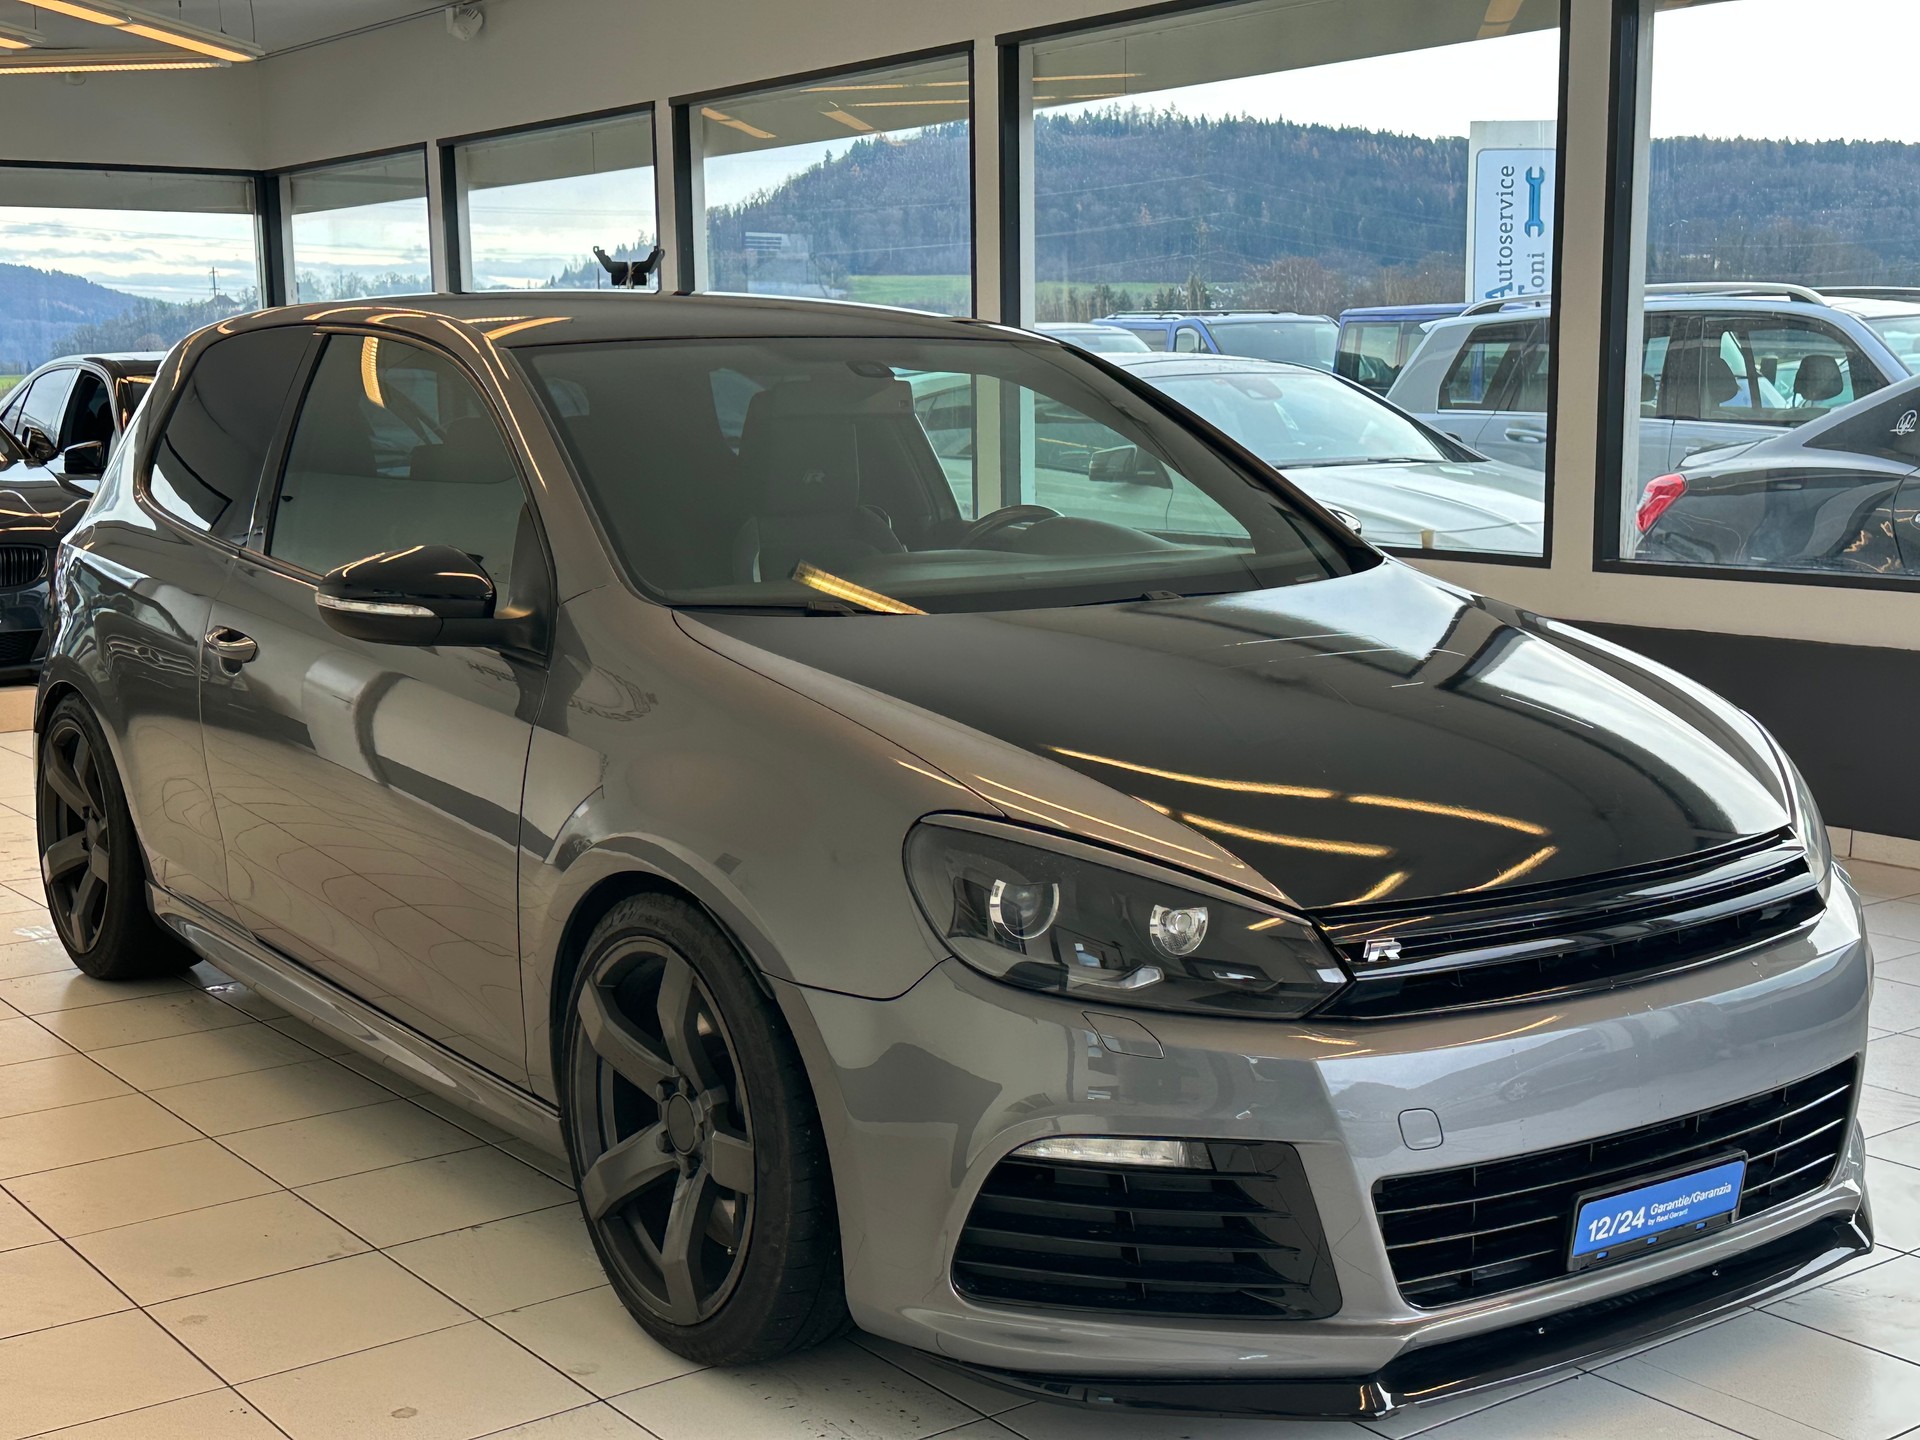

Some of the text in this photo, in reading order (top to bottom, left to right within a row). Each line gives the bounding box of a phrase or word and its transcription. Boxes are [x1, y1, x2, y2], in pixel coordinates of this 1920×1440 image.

[1485, 165, 1515, 299] Autoservice
[1363, 937, 1402, 962] R
[1650, 1182, 1732, 1215] Garantie/Garanzia
[1588, 1206, 1646, 1242] 12/24
